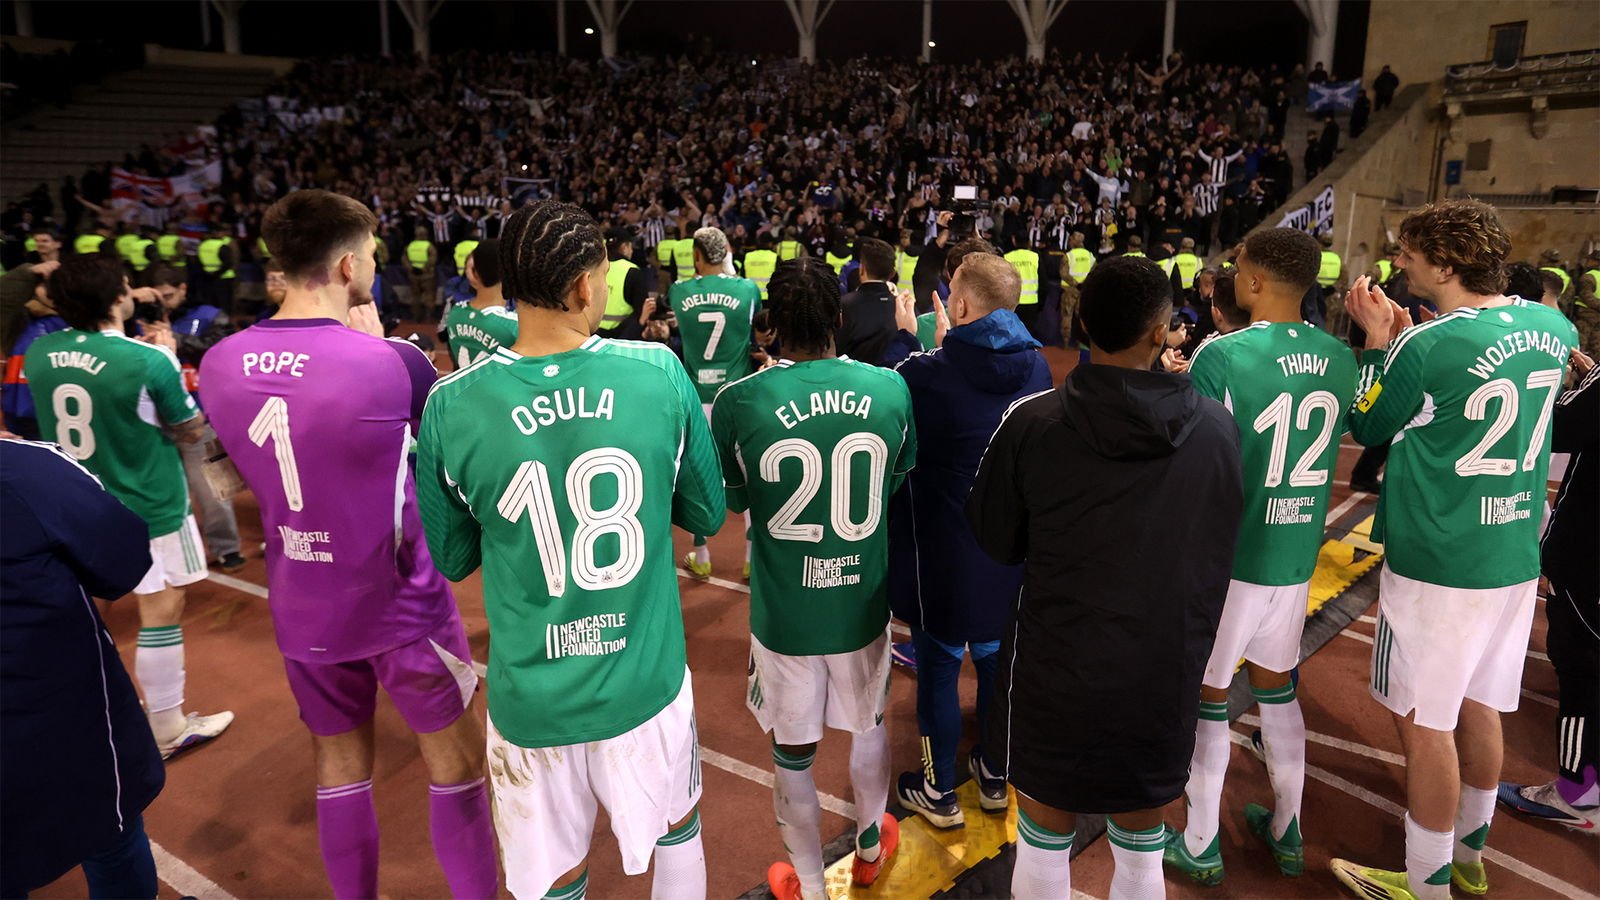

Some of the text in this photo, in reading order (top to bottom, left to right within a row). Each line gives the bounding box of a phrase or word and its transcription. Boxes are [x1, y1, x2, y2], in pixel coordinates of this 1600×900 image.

[681, 292, 741, 312] JOELINTON
[456, 324, 500, 350] RAMSEY
[698, 311, 726, 361] 7
[48, 351, 107, 376] TONALI
[242, 351, 311, 378] POPE
[1276, 352, 1330, 377] THIAW
[1467, 329, 1569, 381] WOLTEMADE
[52, 383, 96, 461] 8
[511, 386, 615, 436] OSULA
[774, 389, 873, 431] ELANGA
[1455, 367, 1563, 478] 27
[1253, 390, 1340, 488] 12
[248, 396, 304, 512] 1
[759, 431, 889, 544] 20
[1276, 506, 1299, 517] UNITED
[1278, 497, 1315, 508] NEWCASTLE
[496, 446, 646, 599] 18
[1275, 514, 1313, 524] FOUNDATION
[812, 555, 860, 569] NEWCASTLE
[812, 567, 841, 580] UNITED
[812, 574, 860, 589] FOUNDATION
[560, 613, 626, 636] NEWCASTLE
[561, 628, 600, 646] UNITED
[562, 636, 627, 657] FOUNDATION
